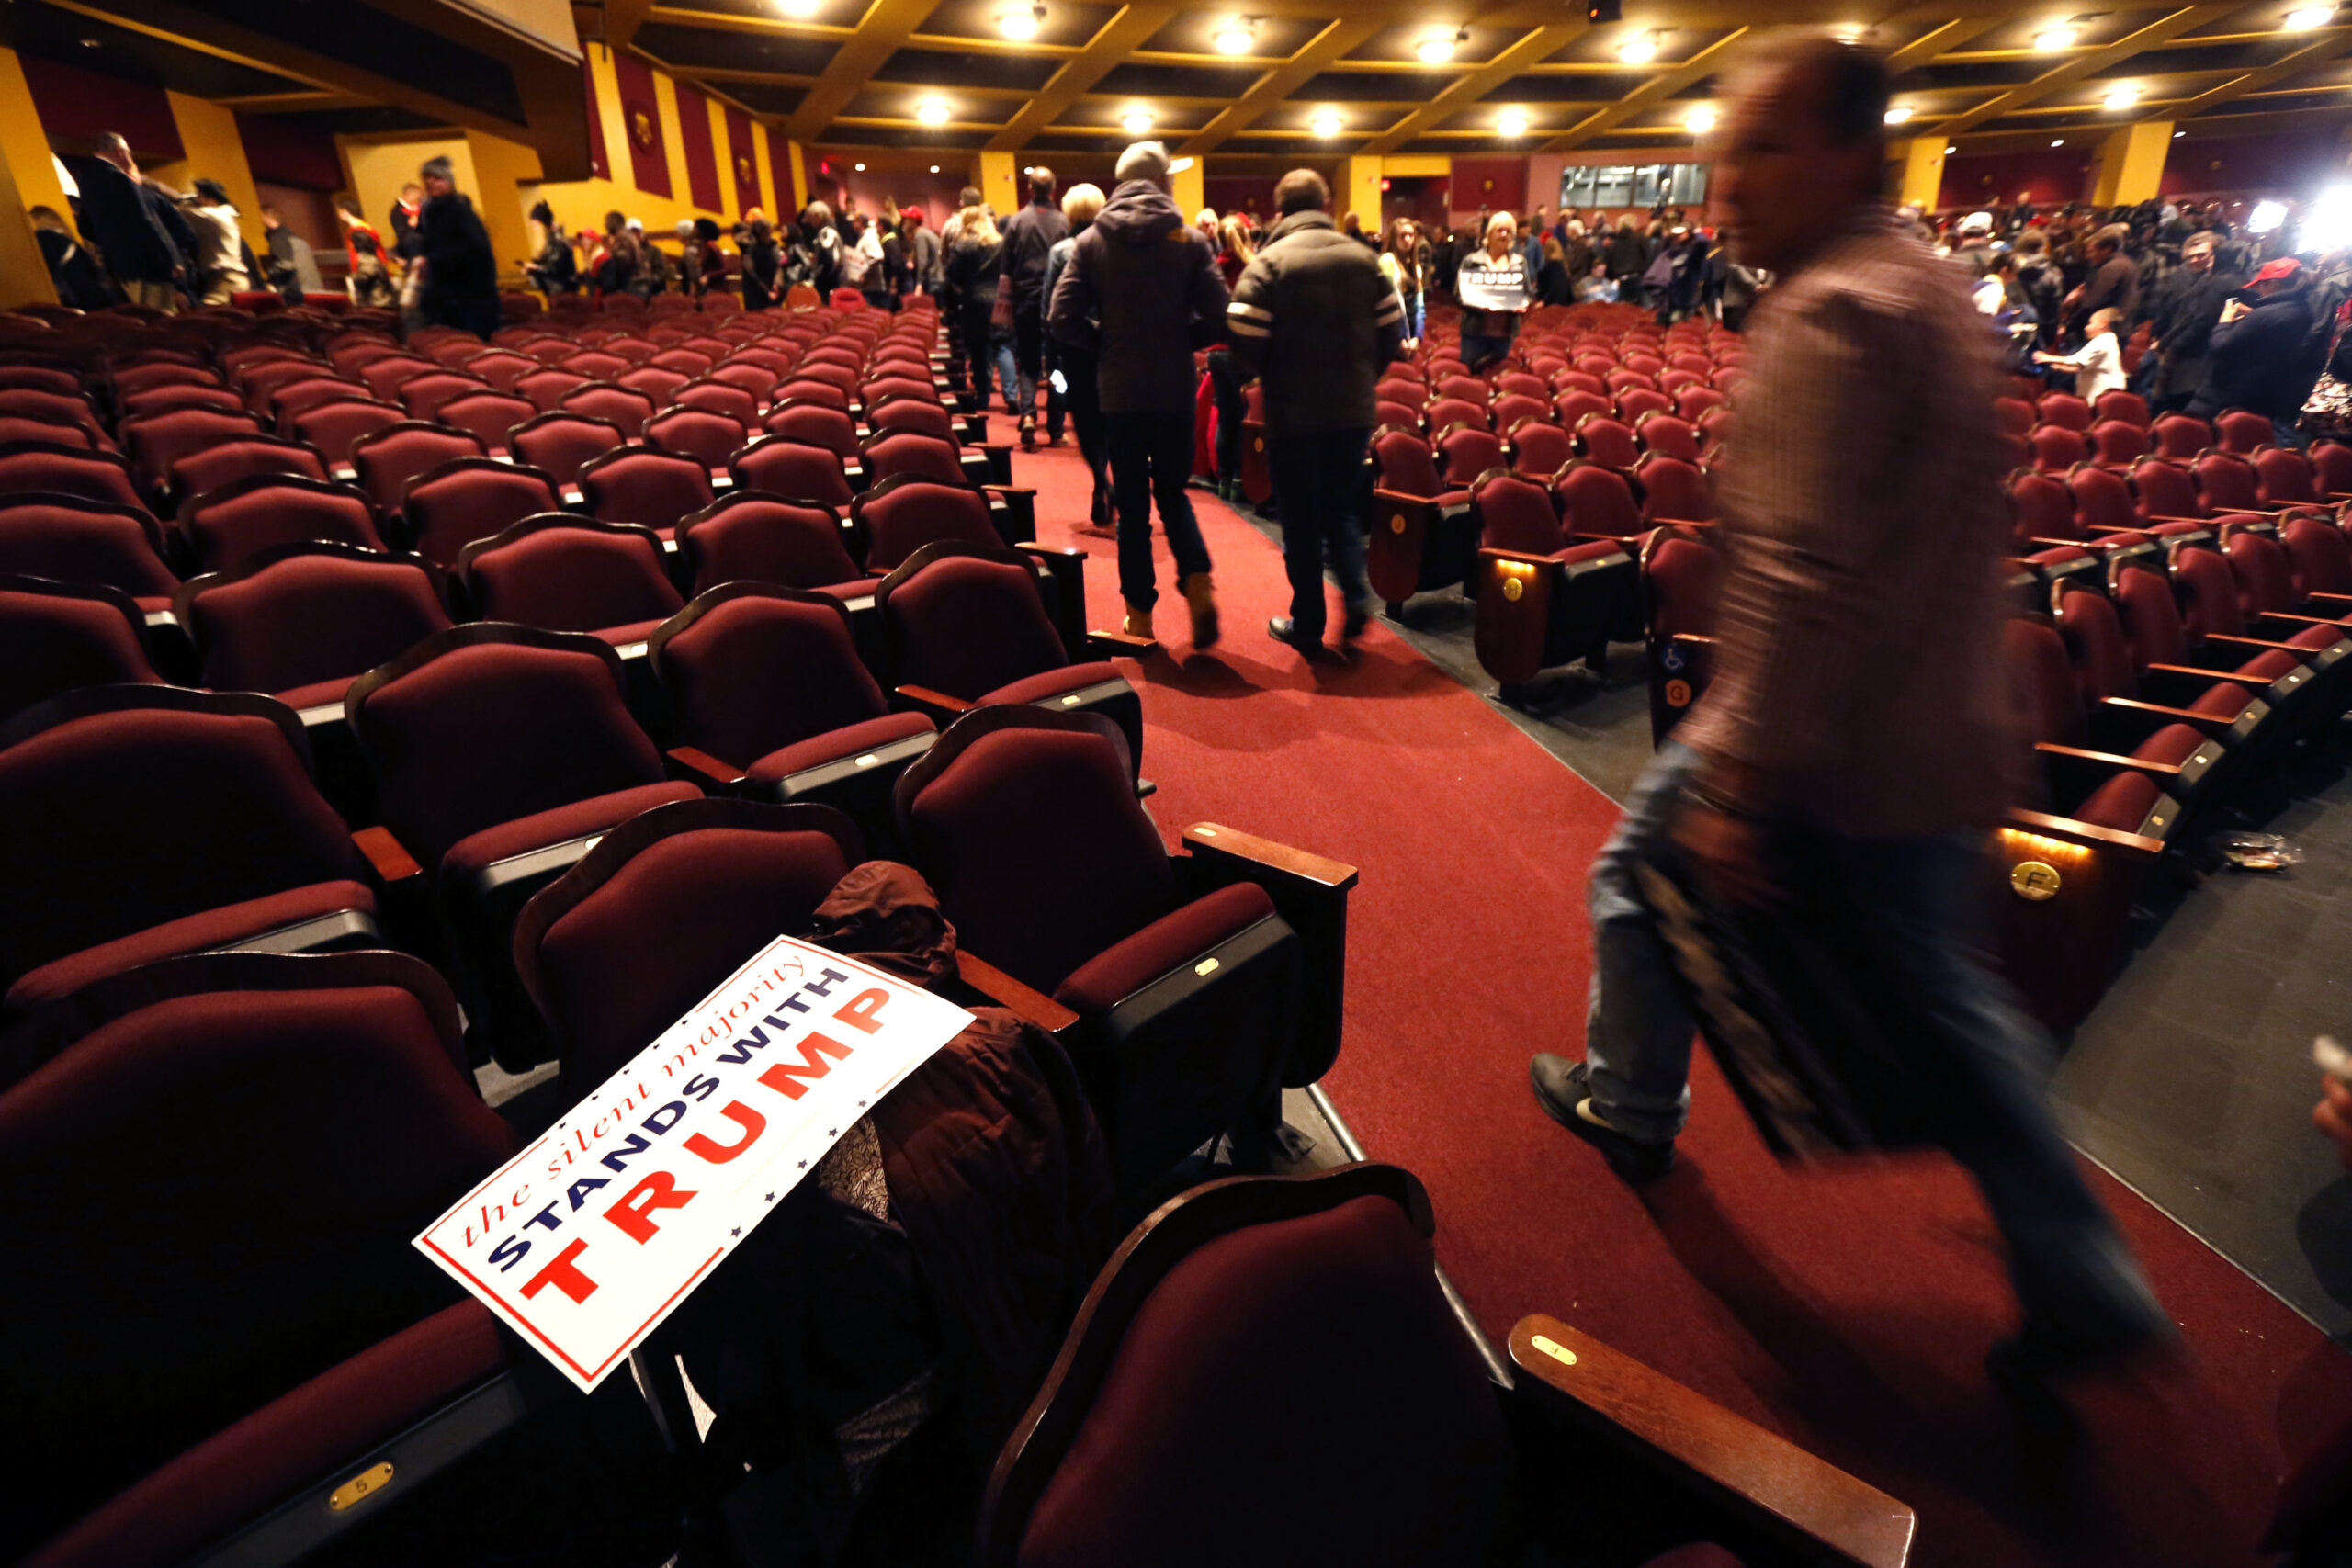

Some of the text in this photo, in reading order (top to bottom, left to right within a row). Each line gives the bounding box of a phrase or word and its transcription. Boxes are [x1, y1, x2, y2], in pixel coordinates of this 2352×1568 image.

[1669, 684, 1684, 701] G
[2025, 870, 2048, 888] F
[461, 955, 805, 1248] the silent majority
[487, 967, 849, 1273] STANDS WITH
[519, 987, 890, 1305] TRUMP
